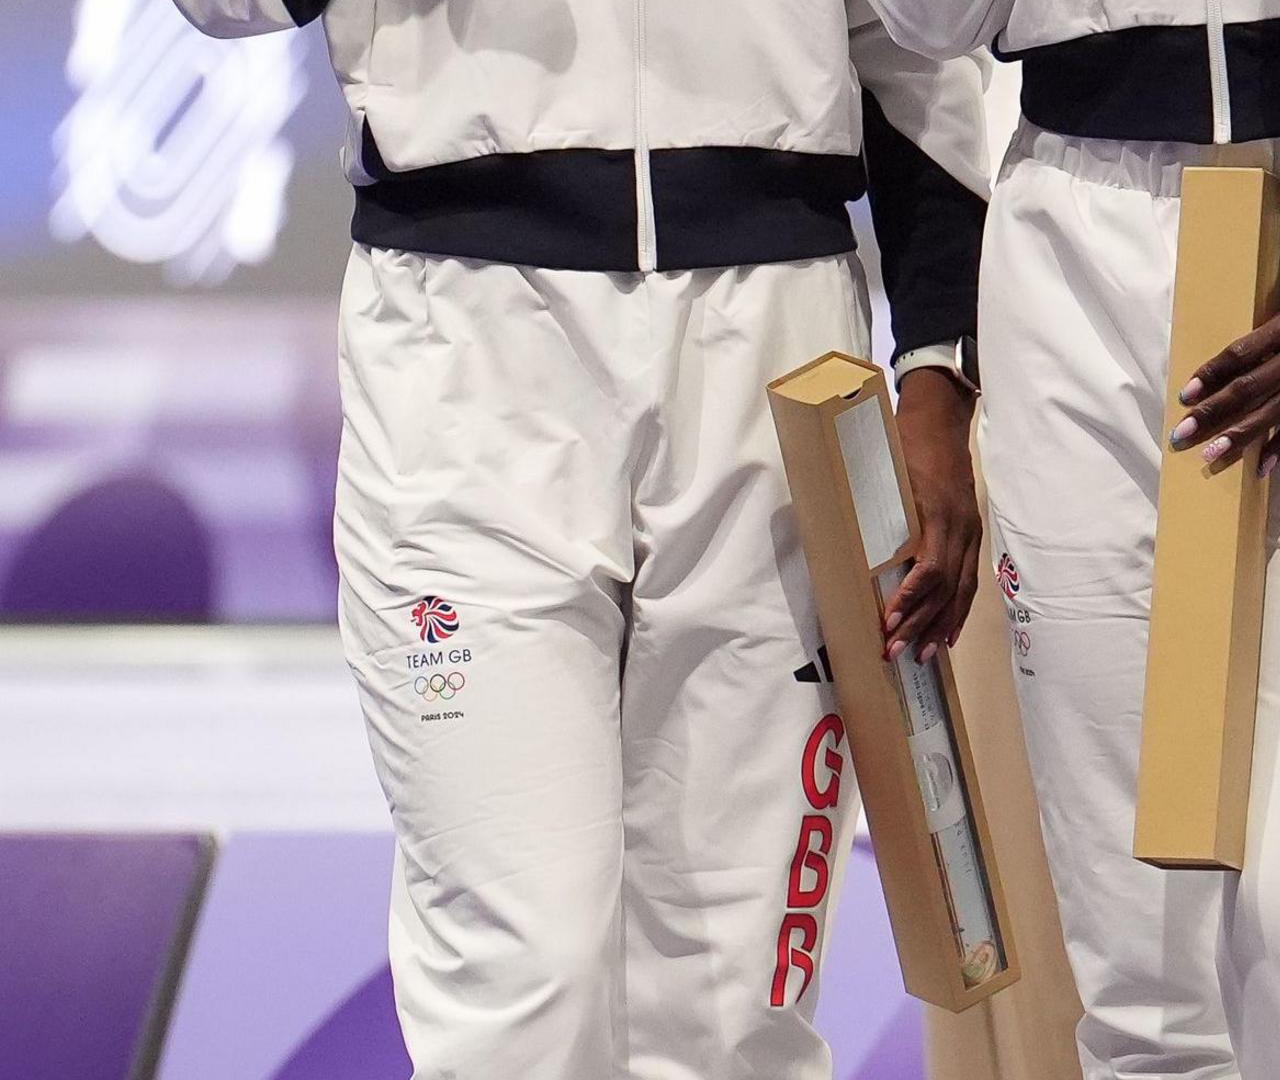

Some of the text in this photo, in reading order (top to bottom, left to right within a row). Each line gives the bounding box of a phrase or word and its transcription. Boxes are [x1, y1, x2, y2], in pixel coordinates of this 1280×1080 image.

[406, 648, 473, 670] TEAM GB
[442, 711, 465, 721] 2024
[770, 713, 845, 1007] GBR
